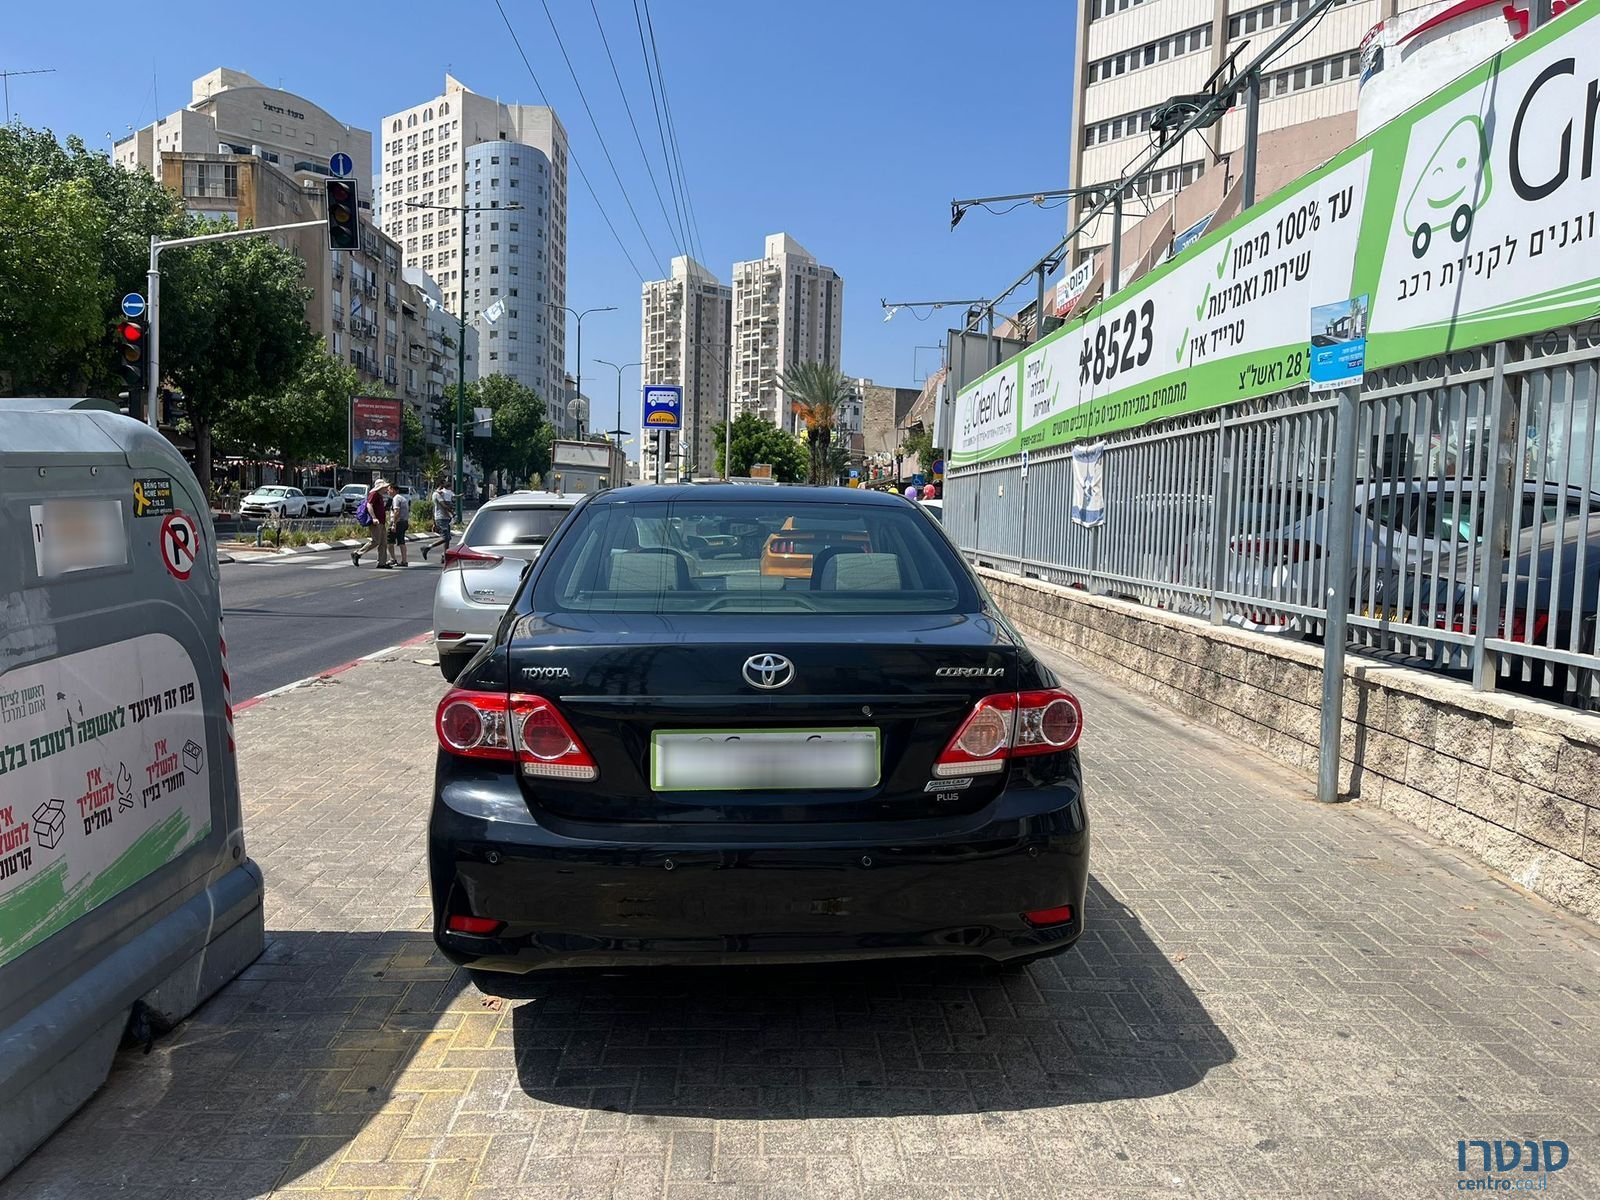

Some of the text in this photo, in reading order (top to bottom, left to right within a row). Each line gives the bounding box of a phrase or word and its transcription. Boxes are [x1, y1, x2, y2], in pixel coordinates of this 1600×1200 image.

[1232, 185, 1353, 280] עד 100% מימון
[1439, 234, 1518, 287] לקניית
[1070, 265, 1089, 291] דפוס
[1207, 250, 1311, 320] שירות ואמינות
[1397, 270, 1431, 301] רכב
[1190, 319, 1245, 368] טרייד אין
[1286, 352, 1302, 379] 28
[997, 376, 1015, 418] Car
[1121, 394, 1150, 418] במכירת
[1152, 381, 1187, 409] מתמחים
[366, 428, 388, 437] 1945
[365, 455, 389, 463] 2024
[521, 667, 570, 678] TOYOTA
[935, 667, 1005, 677] COROLLA
[21, 684, 45, 705] ראשון
[164, 688, 177, 710] זה
[179, 682, 195, 704] פח
[2, 698, 46, 724] אתם במרכז
[128, 694, 162, 723] מיועד
[77, 705, 125, 744] לאשפה
[30, 726, 75, 762] רטובה
[154, 738, 168, 761] אין
[86, 767, 102, 792] אין
[145, 752, 178, 785] להשליך
[76, 781, 115, 818] להשליך
[141, 770, 185, 809] חומרי בניין
[936, 792, 960, 801] PLUS
[0, 805, 14, 835] אי
[83, 806, 113, 836] גחלים
